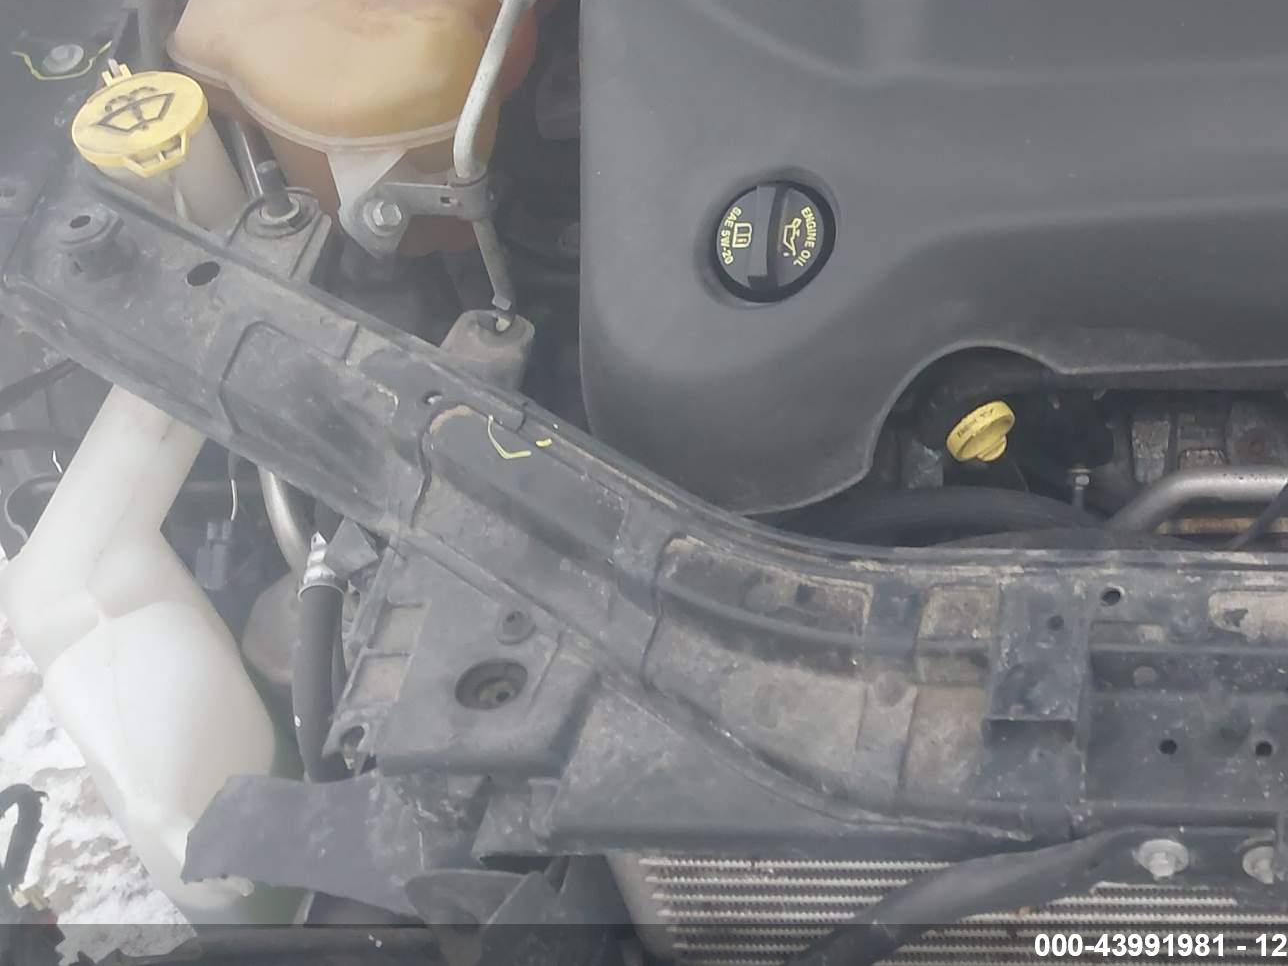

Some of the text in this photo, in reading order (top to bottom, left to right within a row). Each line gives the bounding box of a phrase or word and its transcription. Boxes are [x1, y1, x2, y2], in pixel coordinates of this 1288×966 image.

[720, 206, 743, 265] SAE 5W-20
[793, 206, 817, 267] ENGINE OIL
